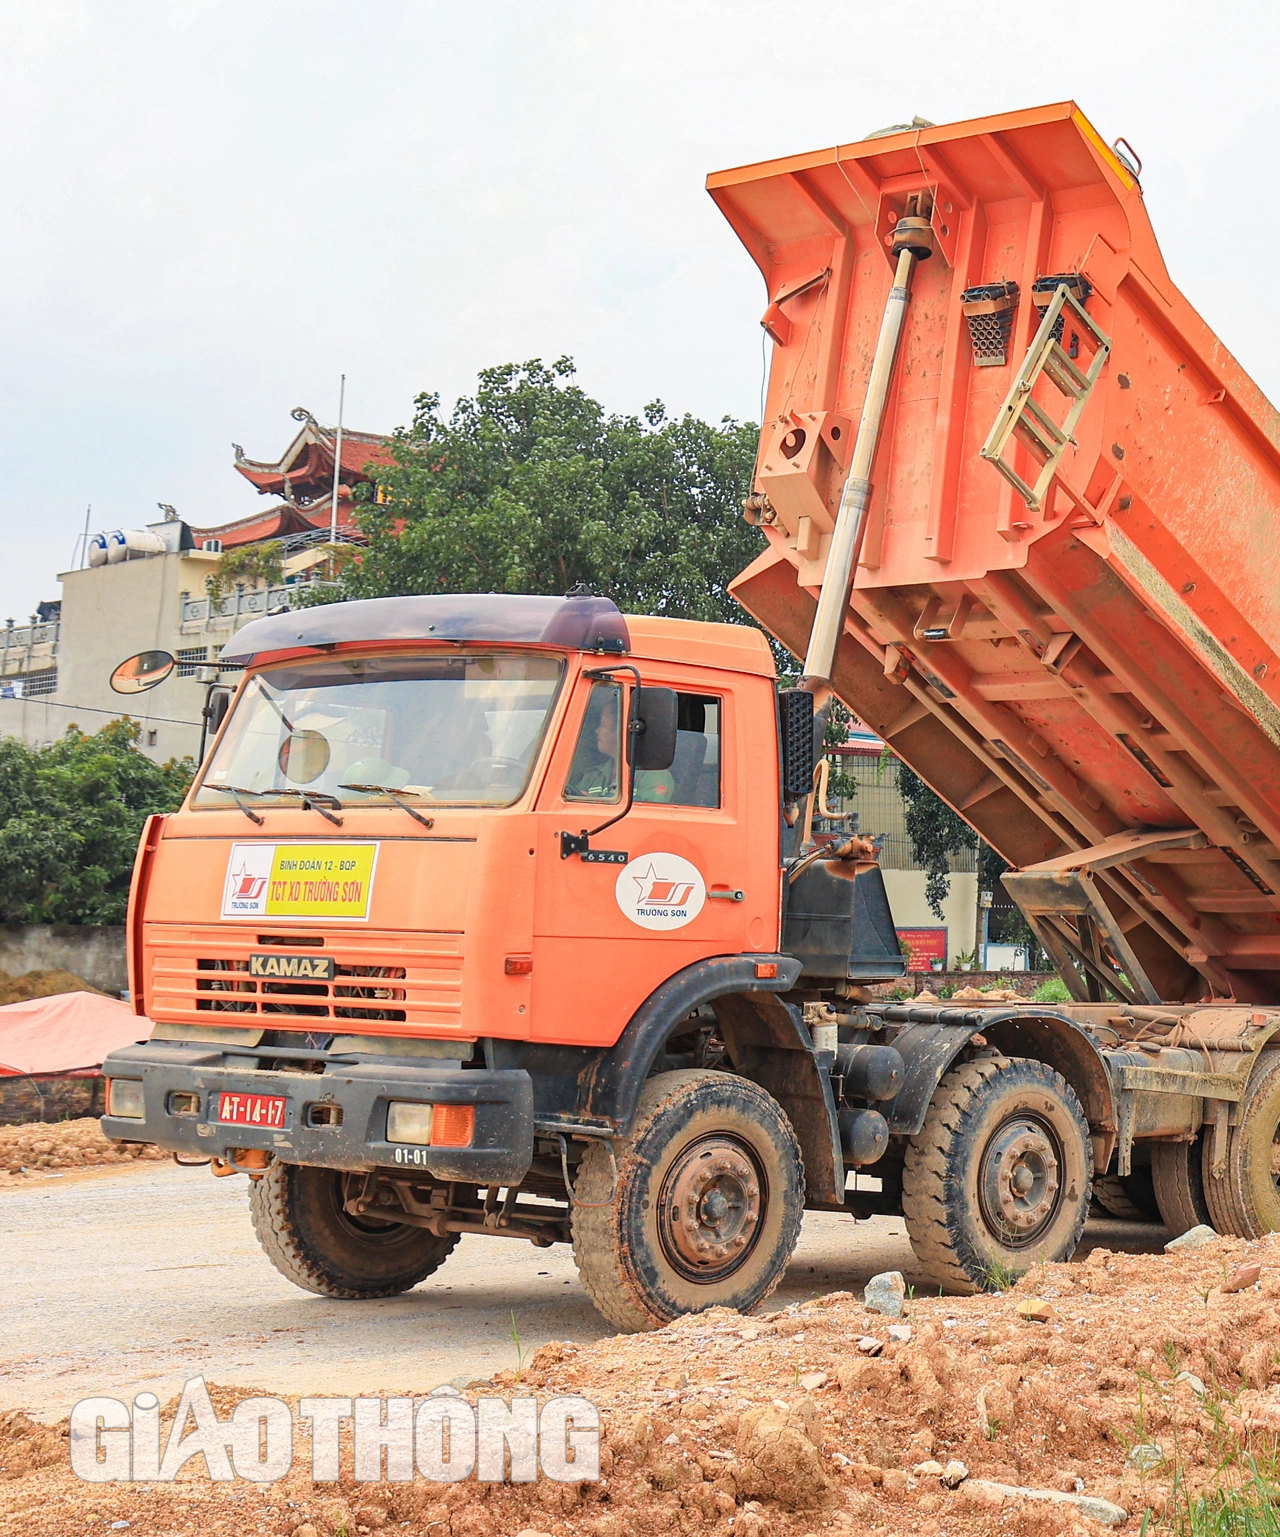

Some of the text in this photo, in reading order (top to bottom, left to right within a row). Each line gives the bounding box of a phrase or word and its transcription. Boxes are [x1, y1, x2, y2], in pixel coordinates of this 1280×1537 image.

[280, 860, 298, 870] BINH
[325, 860, 333, 870] 12
[339, 860, 356, 870] BQP
[588, 853, 625, 862] 6540
[270, 876, 363, 902] TCT XD TRƯỜNG SƠN
[670, 909, 687, 917] SƠN
[250, 957, 329, 978] KAMAZ
[221, 1096, 284, 1126] AT-14-17
[395, 1148, 427, 1165] 01-01
